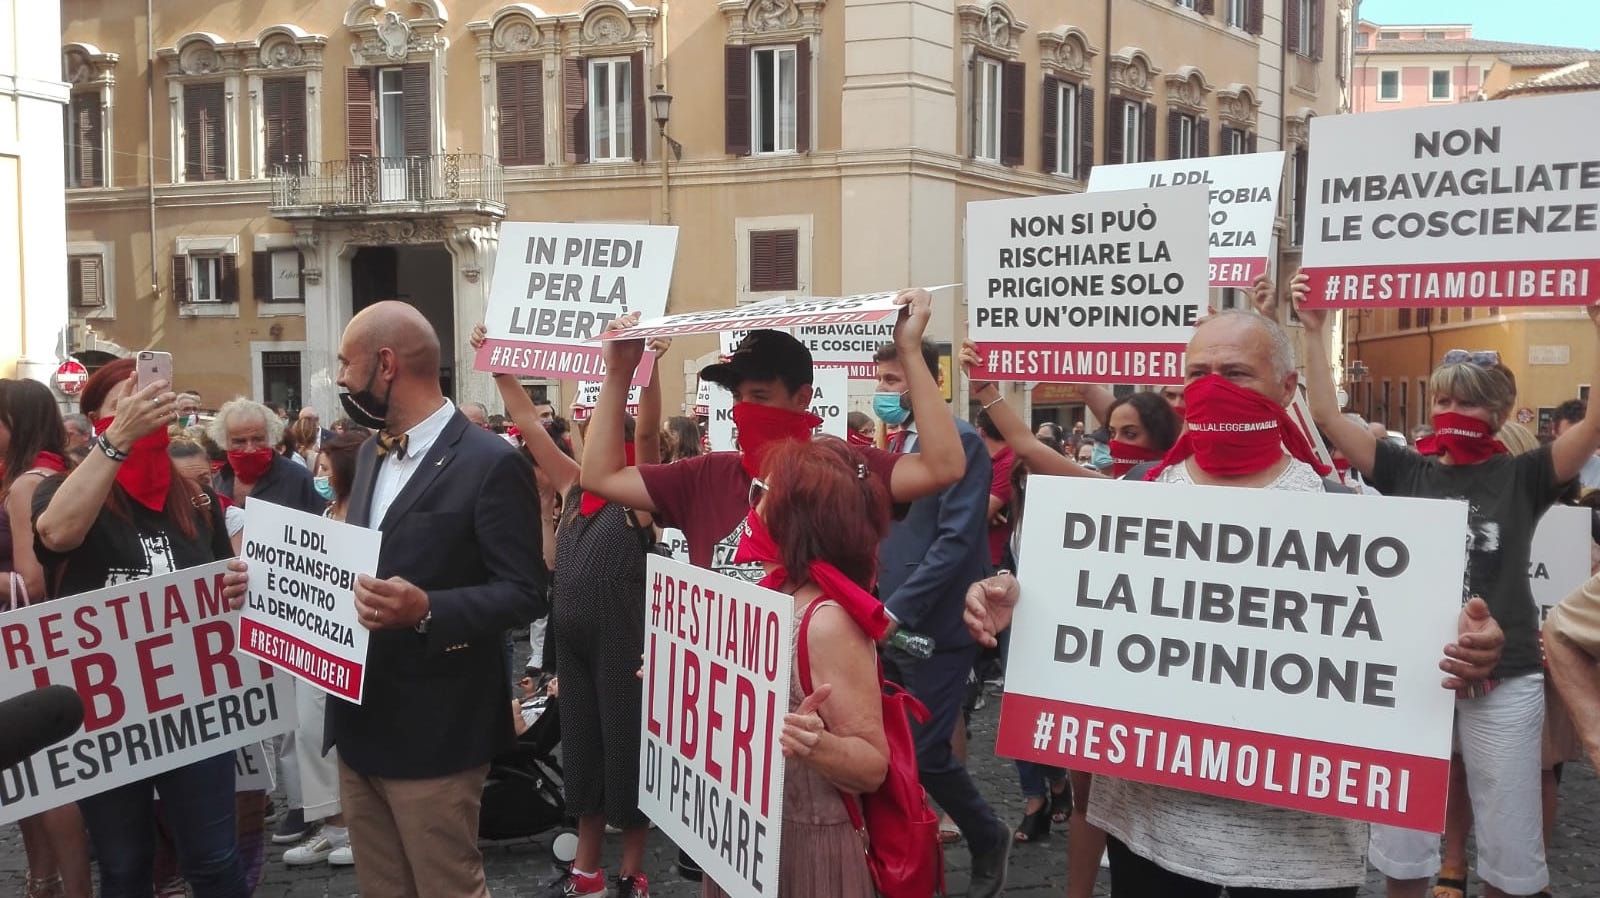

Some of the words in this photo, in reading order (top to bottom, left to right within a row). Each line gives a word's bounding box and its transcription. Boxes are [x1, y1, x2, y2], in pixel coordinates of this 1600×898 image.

[1414, 126, 1501, 159] NON
[1149, 173, 1168, 187] IL
[1171, 169, 1214, 186] DDL
[1321, 160, 1600, 204] IMBAVAGLIATE
[1208, 186, 1272, 205] FOBIA
[1010, 214, 1064, 238] NON
[1071, 213, 1094, 235] SI
[1101, 203, 1157, 233] PUÒ
[1321, 215, 1363, 243] LE
[1371, 203, 1598, 240] COSCIENZE
[525, 236, 557, 266] IN
[563, 237, 643, 268] PIEDI
[999, 242, 1131, 268] RISCHIARE
[1138, 240, 1171, 263] LA
[1208, 231, 1257, 247] AZIA
[526, 272, 583, 302] PER
[589, 275, 627, 305] LA
[988, 274, 1104, 298] PRIGIONE
[1110, 272, 1184, 296] SOLO
[1208, 263, 1251, 282] BERI
[1325, 269, 1589, 301] #RESTIAMOLIBERI
[508, 306, 629, 339] LIBERT
[801, 324, 895, 336] IMBAVAGLIAT
[976, 307, 1019, 327] PER
[987, 350, 1186, 378] #RESTIAMOLIBERI
[811, 405, 840, 418] ATO
[284, 524, 297, 545] IL
[301, 528, 328, 554] DDL
[1062, 511, 1410, 578] DIFENDIAMO
[246, 540, 356, 592] OMOTRANSFOBI
[267, 568, 276, 591] È
[279, 575, 335, 612] CONTRO
[1075, 569, 1138, 614] LA
[1150, 576, 1383, 641] LIBERTÀ
[1, 573, 232, 670] RESTIAM
[248, 591, 265, 613] LA
[268, 597, 355, 648] DEMOCRAZIA
[652, 571, 780, 683] #RESTIAMO
[250, 627, 350, 691] #RESTIAMOLIBERI
[1053, 624, 1104, 667] DI
[1117, 633, 1398, 708] OPINIONE
[647, 632, 776, 819] LIBERI
[0, 755, 39, 807] DI
[47, 683, 279, 790] ESPRIMERCI
[1033, 711, 1410, 813] #RESTIAMOLIBERI
[645, 738, 663, 801] DI
[670, 756, 767, 893] PENSARE
